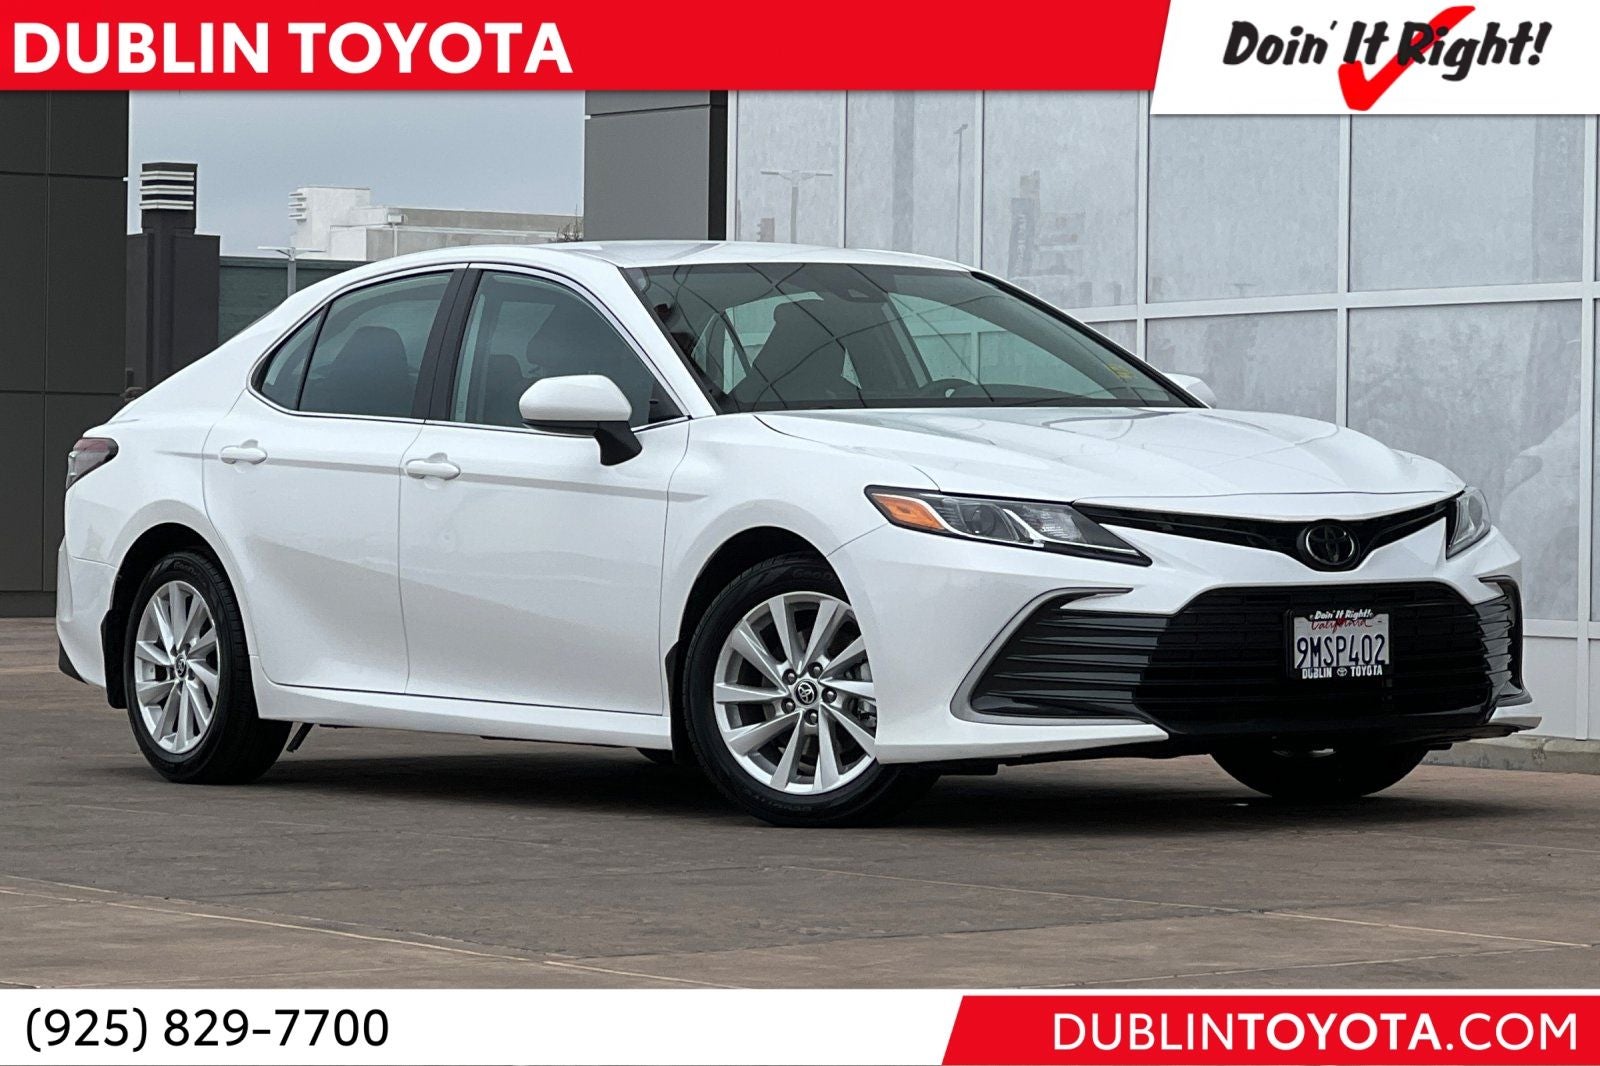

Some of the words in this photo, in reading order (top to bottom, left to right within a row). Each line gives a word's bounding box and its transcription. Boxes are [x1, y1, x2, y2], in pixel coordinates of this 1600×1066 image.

[1335, 609, 1344, 619] It
[1345, 608, 1372, 620] Right!
[1296, 633, 1385, 668] 9MSP402
[1302, 667, 1332, 679] DUBLIN
[1350, 664, 1383, 677] TOYOTA
